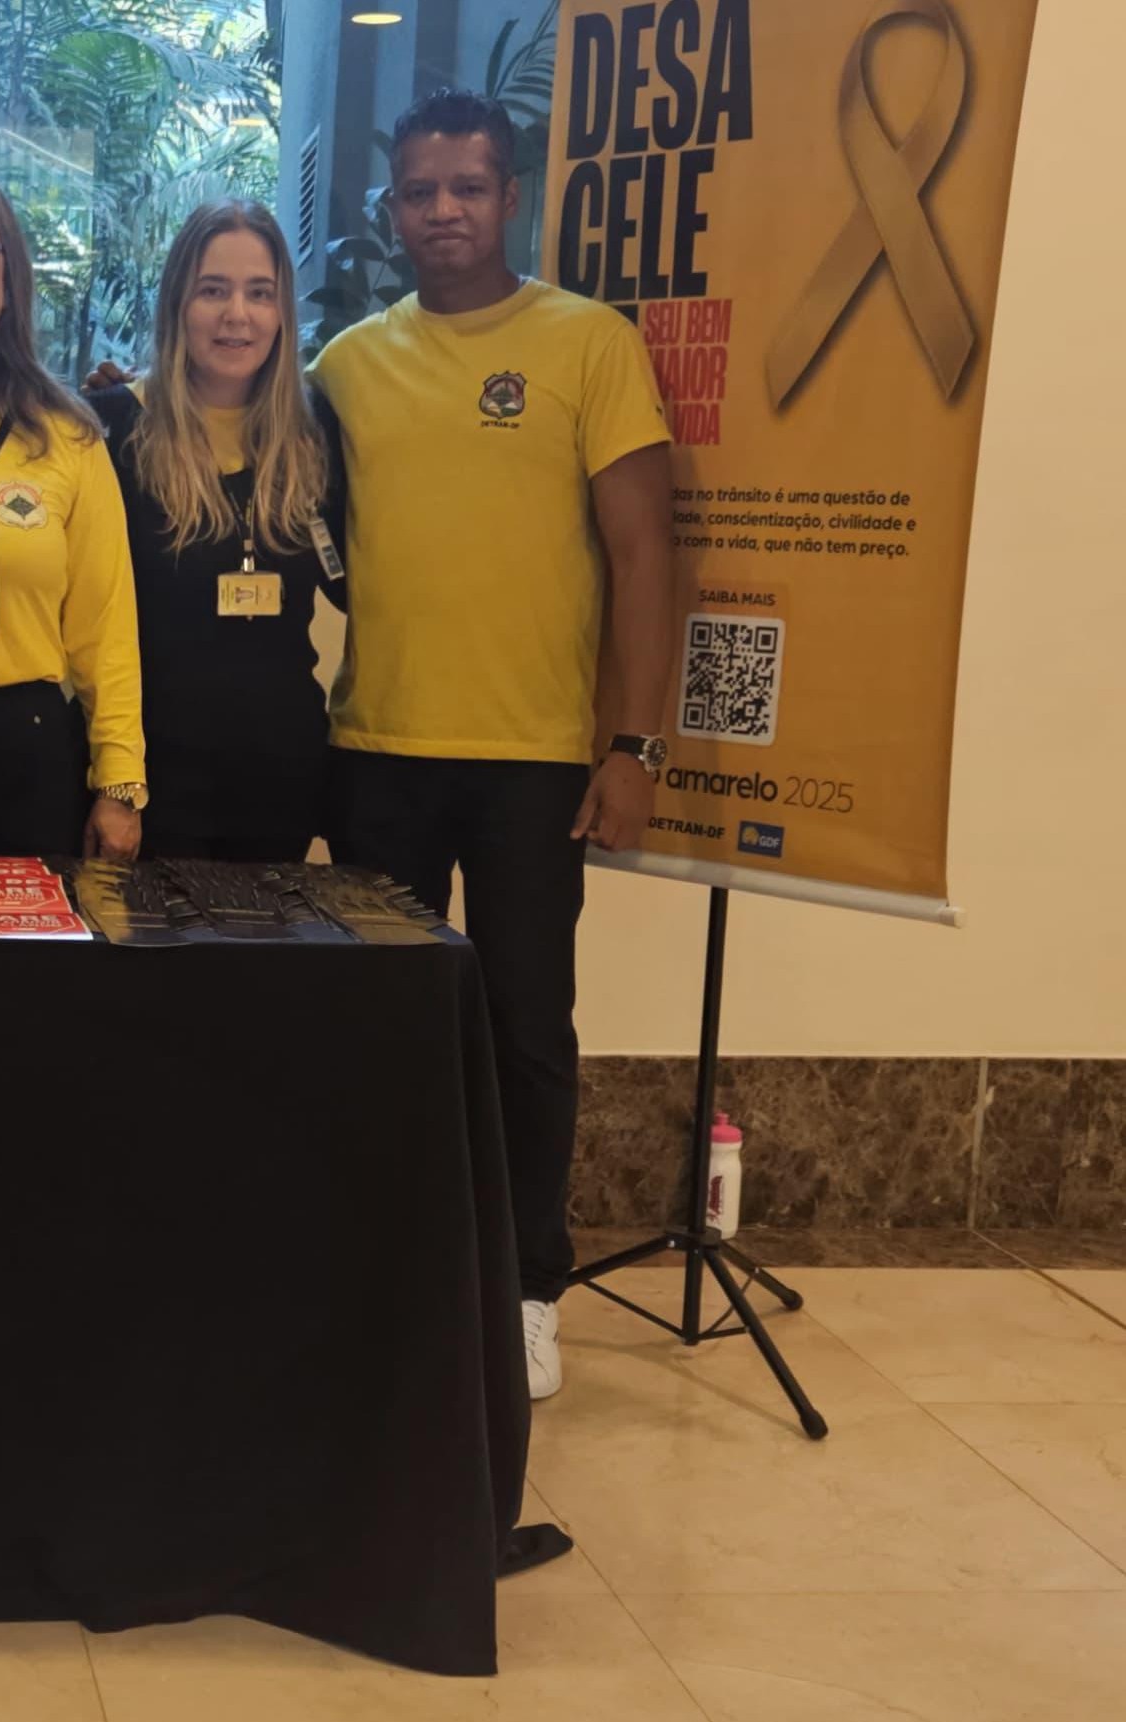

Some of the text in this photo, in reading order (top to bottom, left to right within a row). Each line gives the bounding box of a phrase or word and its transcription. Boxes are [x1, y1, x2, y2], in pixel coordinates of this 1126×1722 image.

[566, 0, 753, 160] DESA
[558, 148, 715, 302] CELE
[644, 301, 683, 346] SEU
[686, 298, 733, 344] BEM
[697, 489, 714, 502] no
[717, 486, 771, 503] trânsito
[775, 487, 784, 503] é
[788, 491, 820, 504] uma
[823, 489, 887, 507] questão
[890, 490, 911, 506] de
[707, 511, 826, 533] conscientização,
[828, 512, 903, 531] civilidade
[906, 518, 917, 531] e
[683, 535, 713, 548] com
[715, 537, 724, 549] a
[728, 533, 761, 552] vida,
[764, 539, 792, 554] que
[794, 537, 823, 553] não
[827, 540, 857, 554] tem
[859, 542, 910, 560] preço.
[699, 587, 778, 607] SAIBA MAIS
[665, 766, 779, 803] amarelo
[782, 776, 855, 814] 2025
[648, 816, 782, 849] DETRAN-DF GDF
